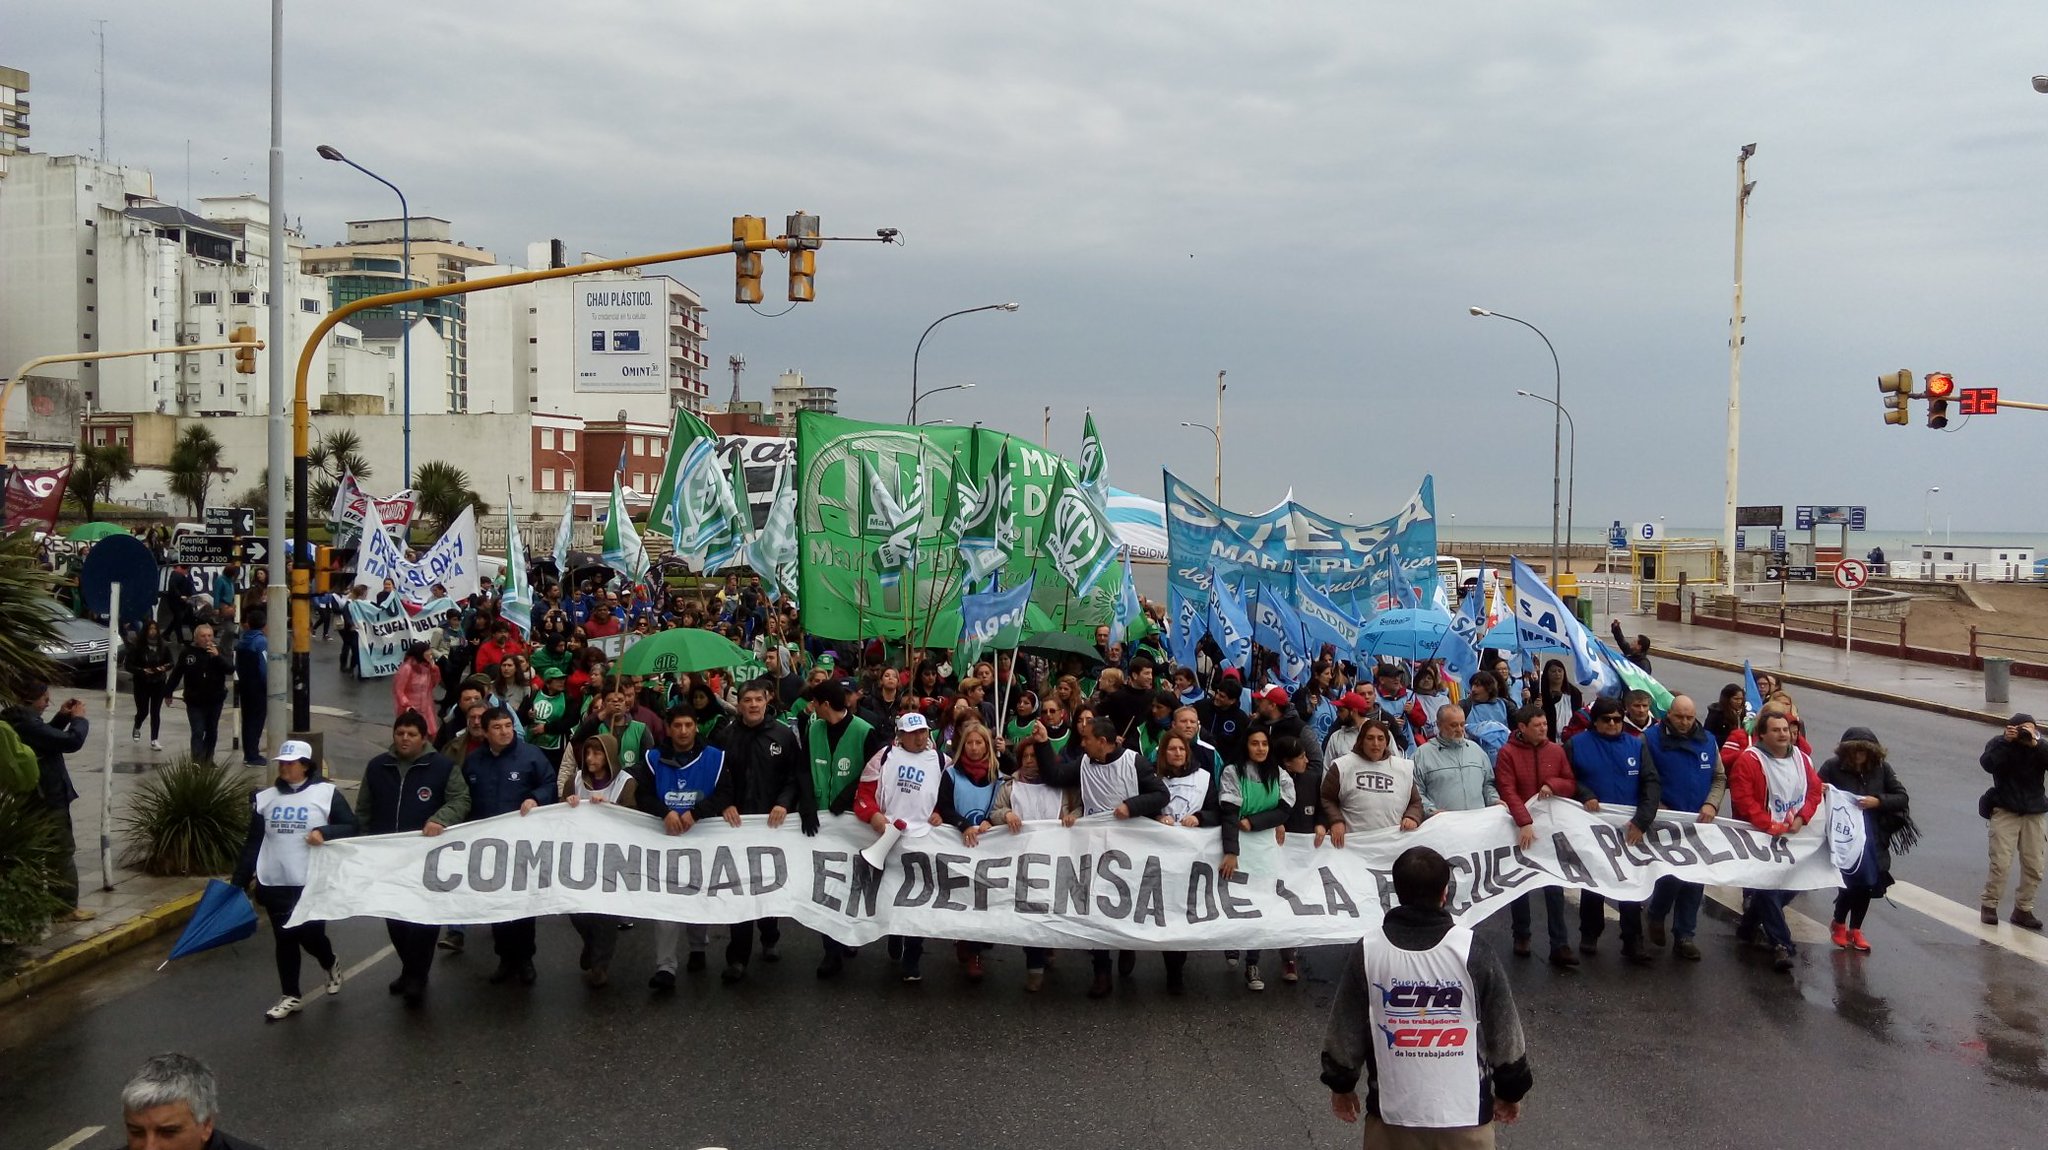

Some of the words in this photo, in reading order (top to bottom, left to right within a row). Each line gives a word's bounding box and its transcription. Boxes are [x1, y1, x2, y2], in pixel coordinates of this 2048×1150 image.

[586, 292, 609, 307] CHAU
[611, 289, 653, 307] PLÁSTICO.
[622, 365, 650, 377] OMINT
[1961, 389, 1997, 413] 32
[1644, 525, 1652, 538] E
[181, 537, 208, 545] Avenida
[180, 545, 202, 553] Pedro
[205, 545, 222, 553] Luro
[1211, 539, 1278, 572] MAR
[180, 554, 199, 562] 2200
[211, 555, 228, 563] 2100
[898, 765, 925, 783] CCC
[1356, 775, 1394, 790] CTEP
[271, 806, 309, 821] CCC
[422, 838, 788, 897] COMUNIDAD
[812, 849, 884, 917] EN
[893, 849, 1166, 927] DEFENSA
[1186, 861, 1263, 924] DE
[1275, 866, 1360, 918] LA
[1367, 831, 1598, 916] ECUELA
[1388, 986, 1463, 1008] CTA
[1412, 1018, 1460, 1026] trabajadores
[1394, 1028, 1469, 1048] CTA
[1417, 1050, 1465, 1059] trabajadores
